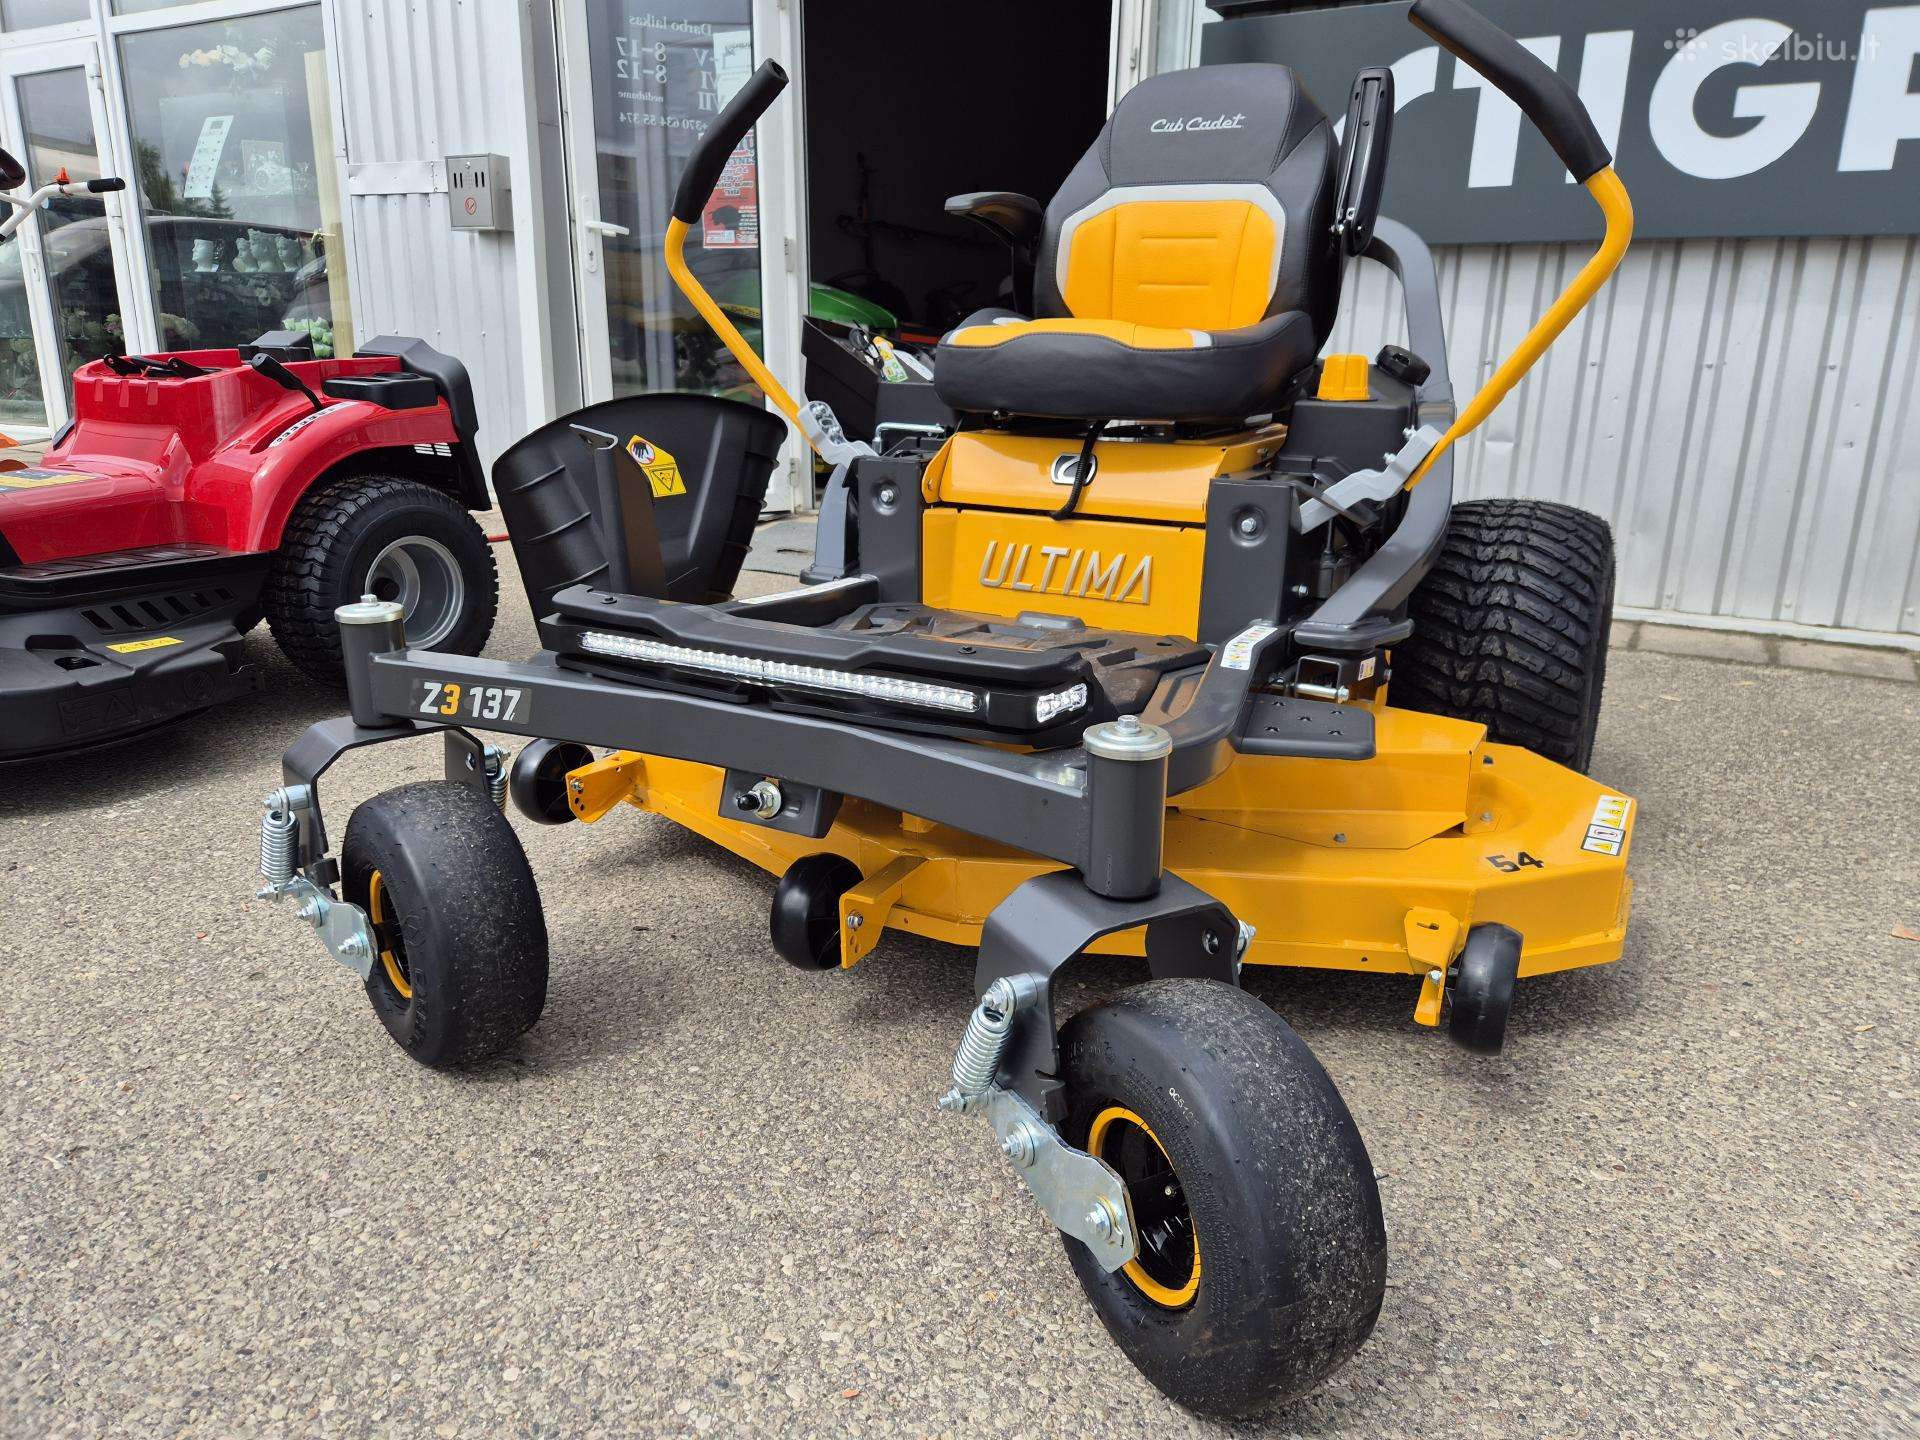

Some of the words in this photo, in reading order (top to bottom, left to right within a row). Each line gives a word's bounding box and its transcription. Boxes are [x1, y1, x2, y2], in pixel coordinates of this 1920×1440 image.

[1150, 117, 1184, 133] Cub
[1185, 112, 1247, 131] Cadet
[979, 539, 1153, 606] ULTIMA
[419, 681, 461, 715] Z3
[469, 686, 521, 721] 137
[1485, 851, 1545, 873] 54
